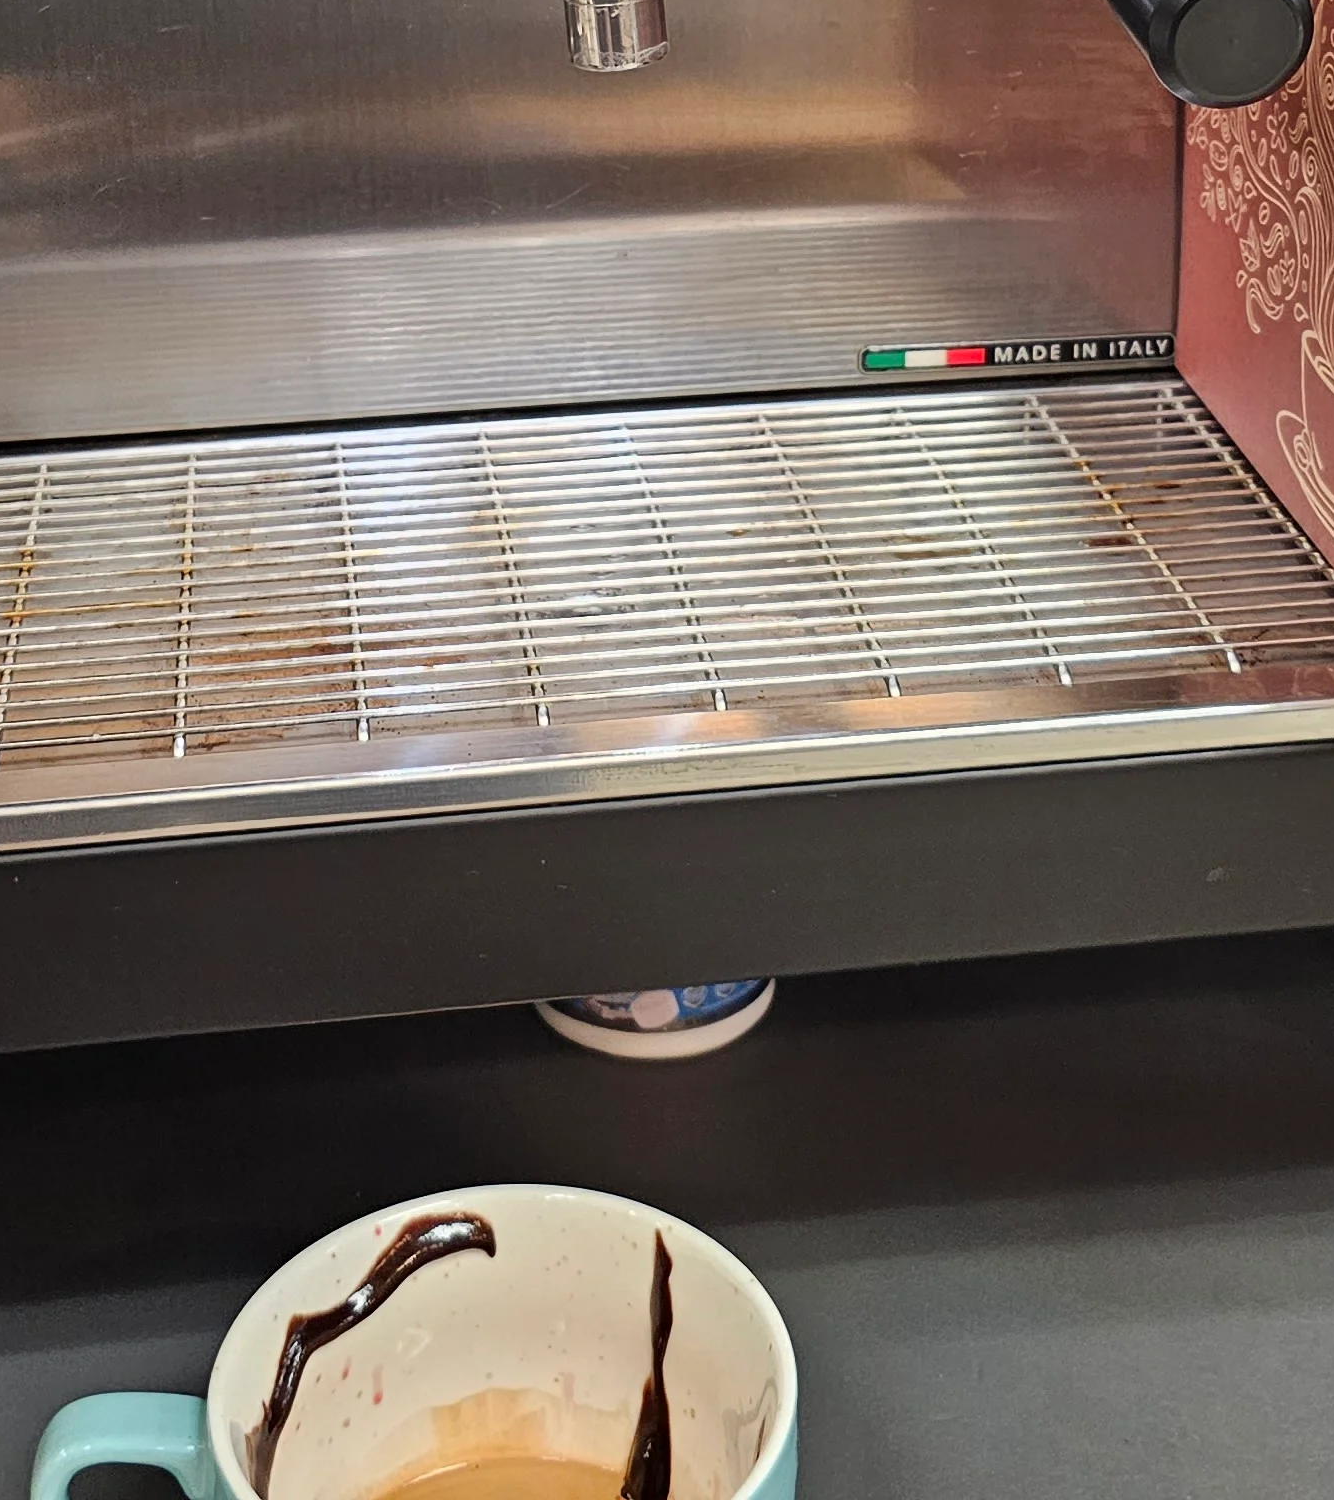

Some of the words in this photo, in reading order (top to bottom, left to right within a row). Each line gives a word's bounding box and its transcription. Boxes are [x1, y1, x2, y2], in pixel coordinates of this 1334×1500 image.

[994, 343, 1061, 363] MADE
[1073, 342, 1097, 359] IN
[1108, 338, 1169, 357] ITALY
